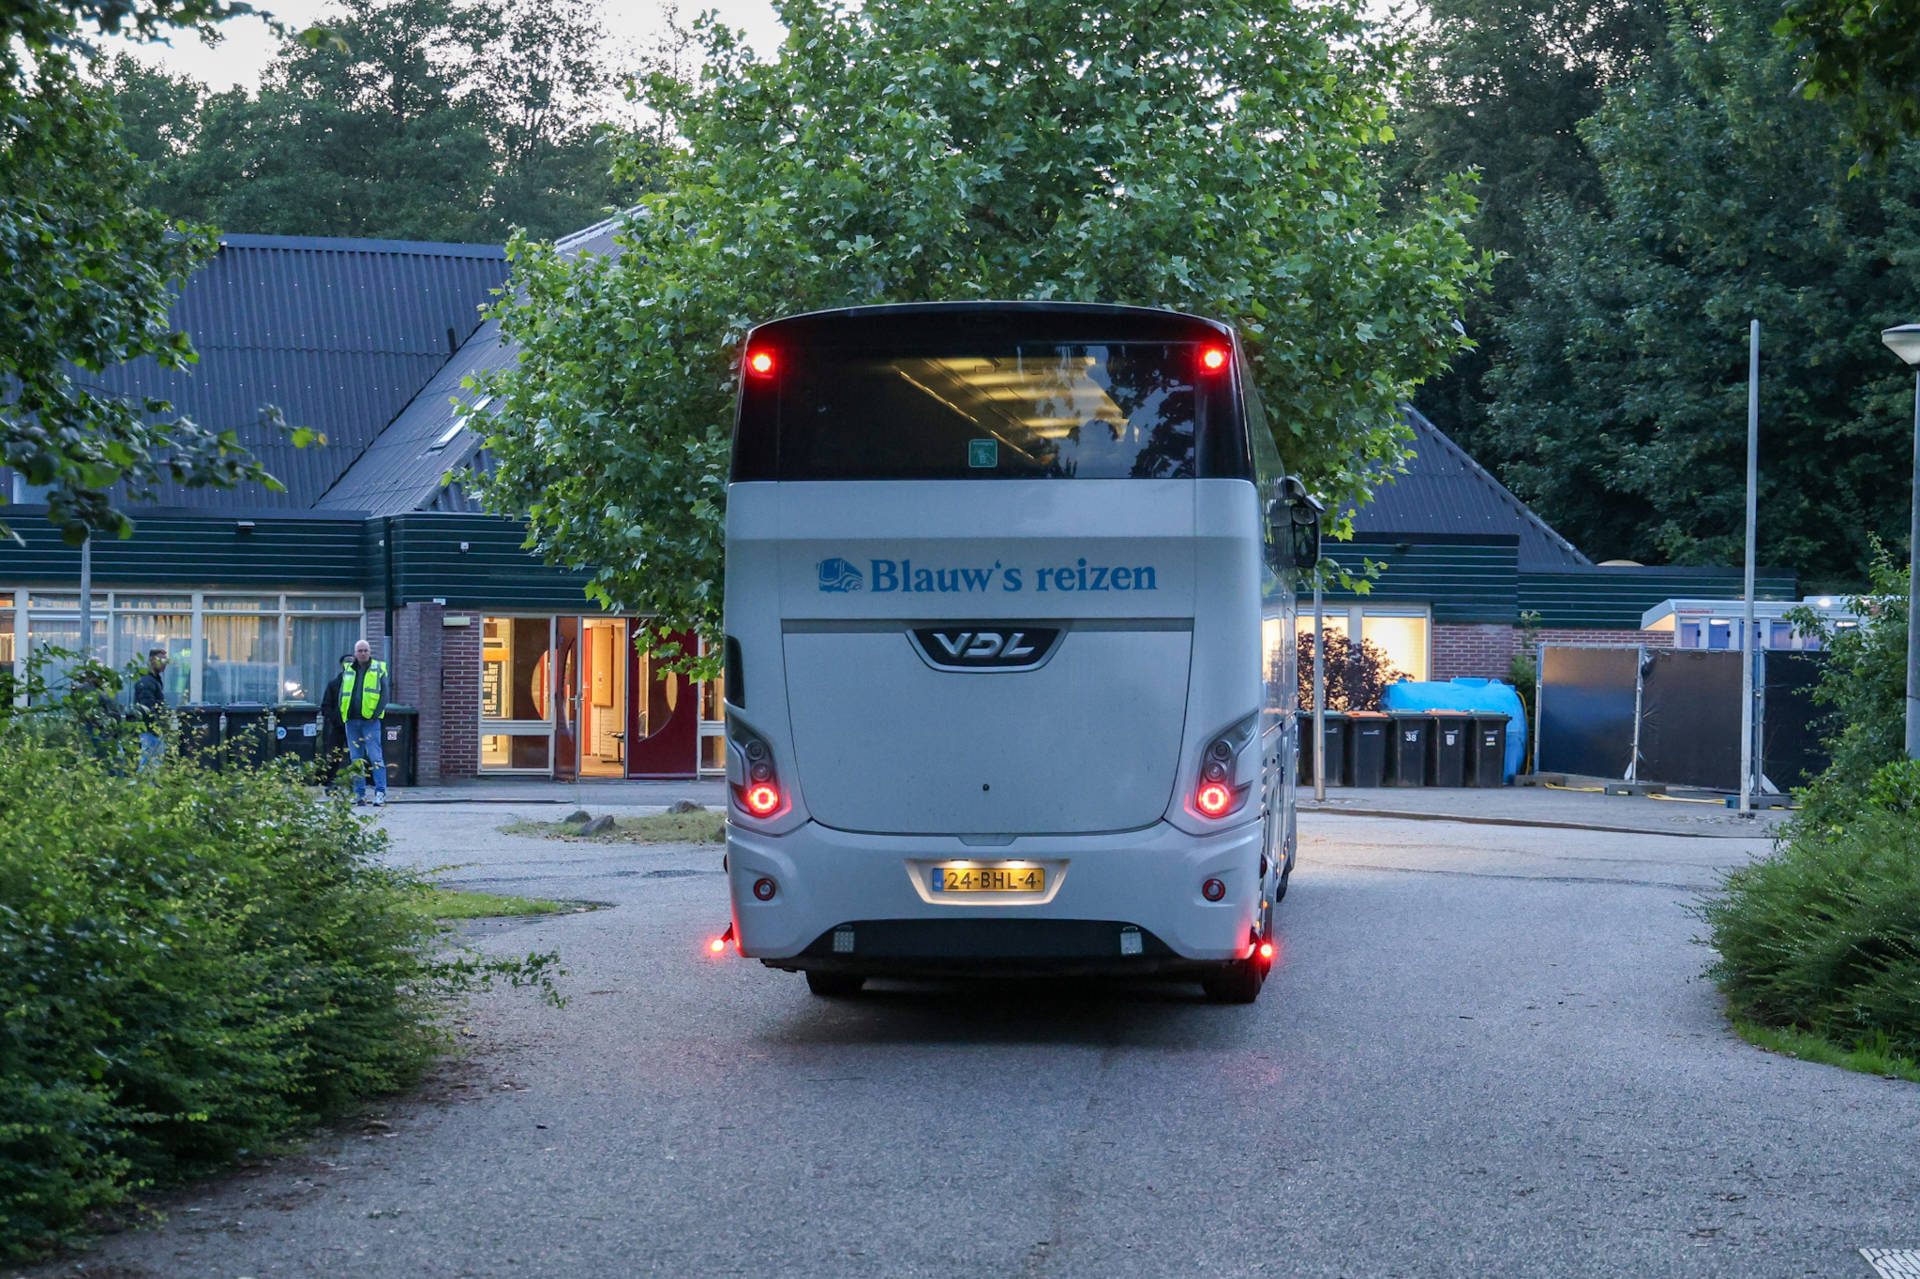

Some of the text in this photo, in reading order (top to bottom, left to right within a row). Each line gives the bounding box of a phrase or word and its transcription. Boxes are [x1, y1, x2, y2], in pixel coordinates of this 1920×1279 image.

[870, 557, 1158, 594] Blauw's reizen
[931, 632, 1036, 658] VDL
[1405, 733, 1417, 742] 38
[948, 871, 1037, 890] 24-BHL-4
